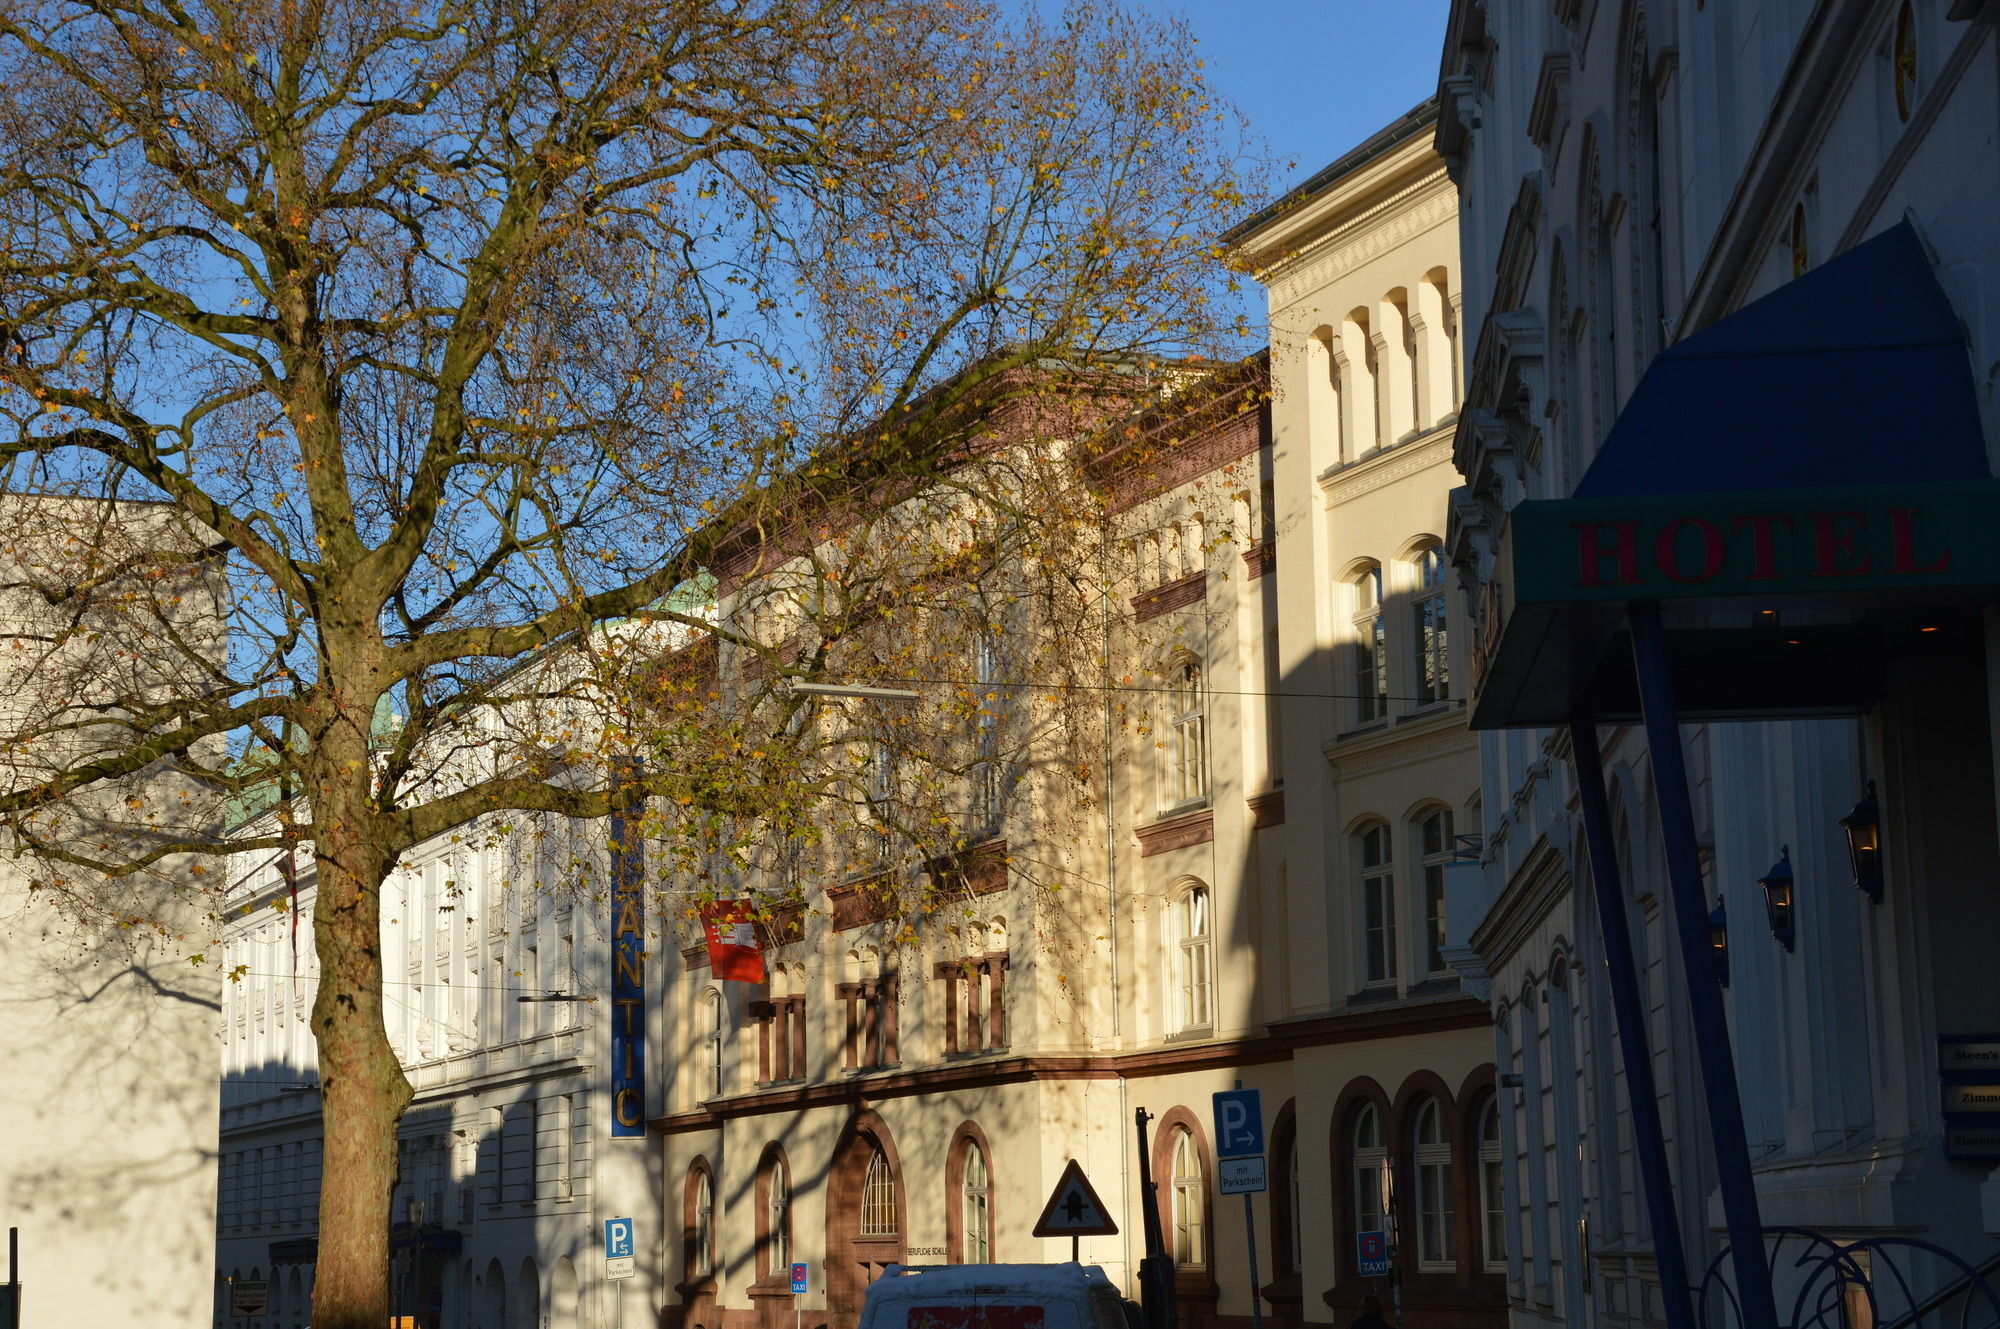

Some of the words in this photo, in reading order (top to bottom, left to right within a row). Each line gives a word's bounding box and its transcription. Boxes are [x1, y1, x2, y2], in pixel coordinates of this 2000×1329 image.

[1570, 508, 1952, 586] HOTEL
[1953, 1050, 1999, 1060] Steen's
[1961, 1093, 2000, 1103] Zimm
[1221, 1100, 1247, 1149] P
[1236, 1166, 1248, 1175] mit
[1223, 1177, 1262, 1187] Parkschein
[612, 1223, 627, 1254] P
[907, 1247, 931, 1256] BERUFLICHE
[932, 1247, 948, 1256] SCHULE
[1362, 1260, 1385, 1272] TAXI
